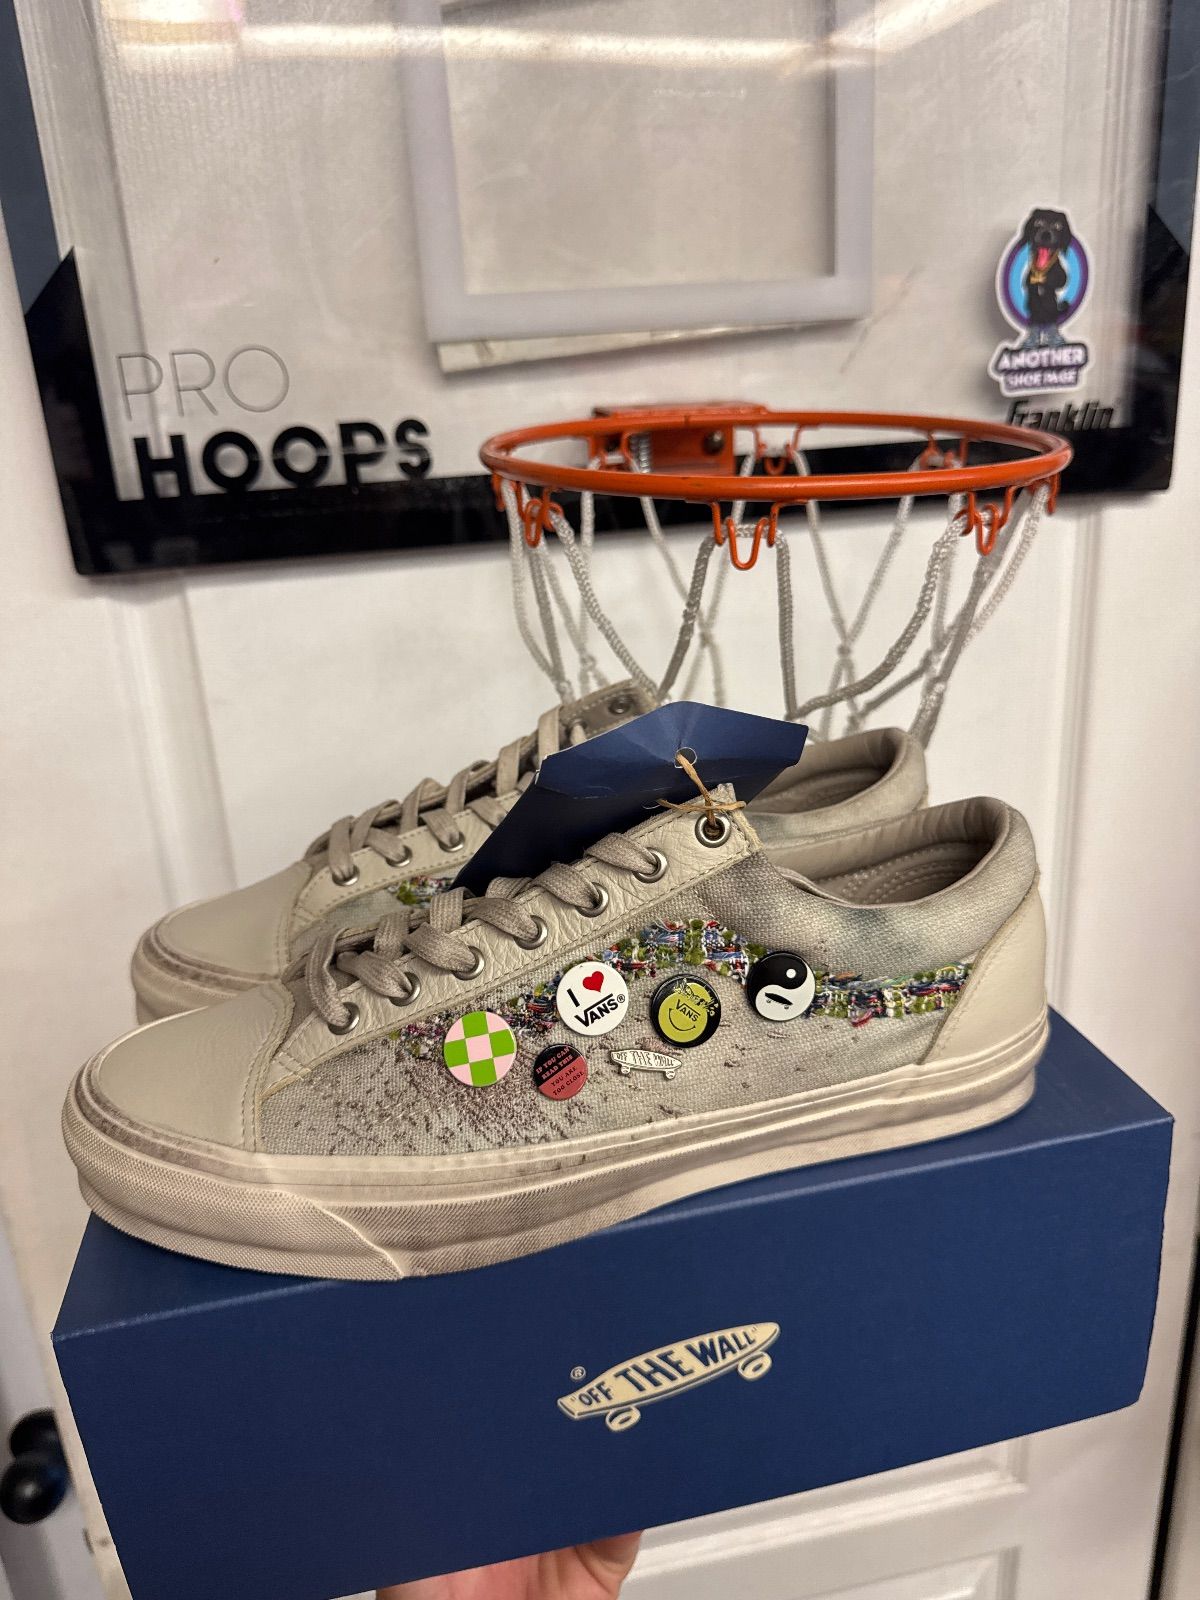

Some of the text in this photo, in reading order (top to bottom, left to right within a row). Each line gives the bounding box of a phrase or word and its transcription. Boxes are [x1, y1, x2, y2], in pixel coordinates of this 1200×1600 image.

[998, 347, 1083, 370] ANOTHER
[116, 344, 290, 421] PRO
[1007, 373, 1042, 387] SHOE
[1006, 400, 1114, 431] Franklin
[132, 418, 432, 498] HOOPS
[566, 988, 580, 1008] I
[676, 999, 701, 1022] VANS
[541, 1054, 574, 1080] READ THIS
[543, 1056, 557, 1069] YOU
[556, 1046, 571, 1059] CAN
[550, 1065, 577, 1088] YOU ARE
[613, 1349, 695, 1393] THE
